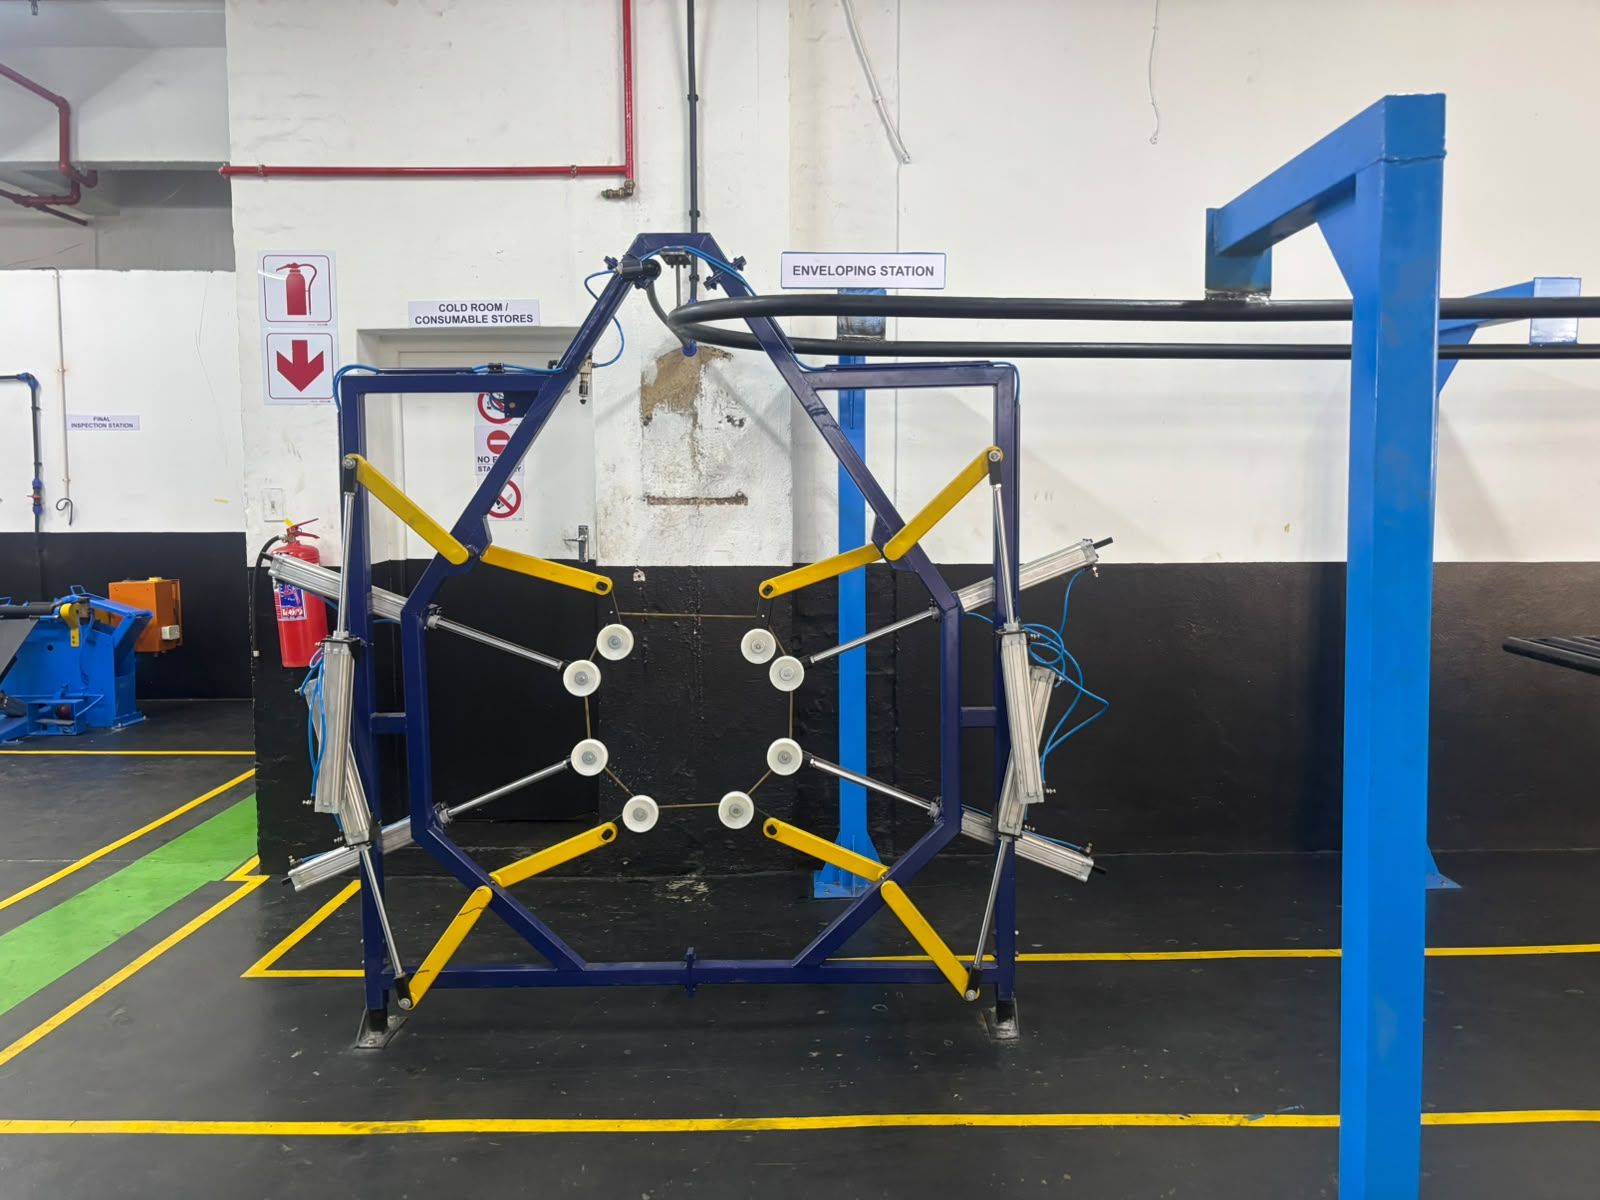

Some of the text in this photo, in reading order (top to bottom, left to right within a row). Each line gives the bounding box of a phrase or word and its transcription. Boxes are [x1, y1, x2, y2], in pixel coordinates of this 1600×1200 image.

[793, 265, 934, 276] ENVELOPING STATION
[439, 303, 468, 312] COLD
[471, 303, 503, 312] ROOM
[415, 314, 534, 325] CONSUMABLE STORES
